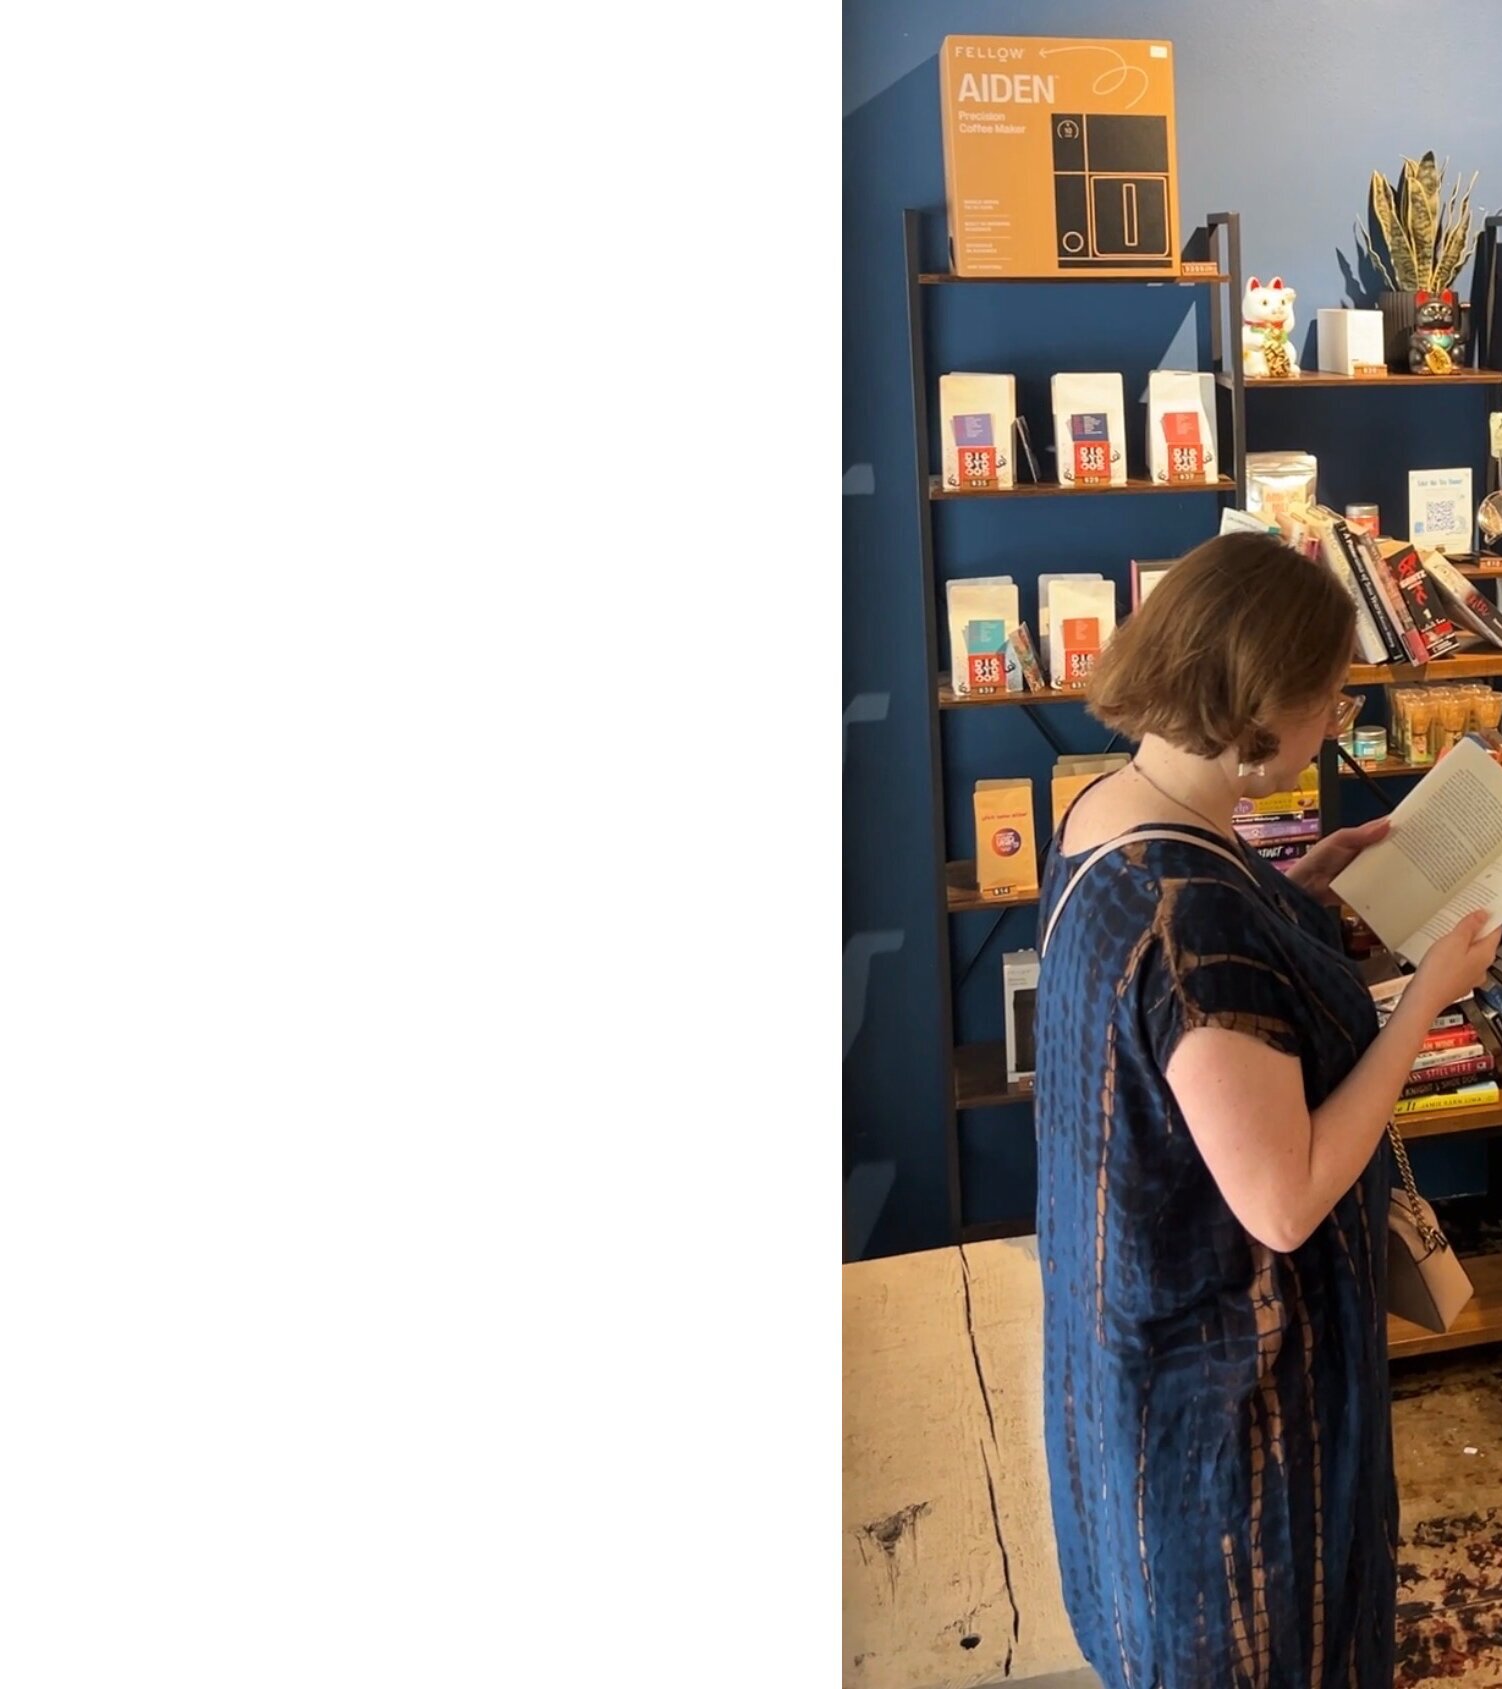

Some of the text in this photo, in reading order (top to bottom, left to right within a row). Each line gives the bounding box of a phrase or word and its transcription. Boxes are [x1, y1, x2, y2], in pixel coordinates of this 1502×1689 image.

[955, 46, 1024, 63] FELLOW
[958, 73, 1055, 104] AIDEN
[958, 111, 1006, 122] Precision
[959, 123, 1026, 134] Coffee Maker
